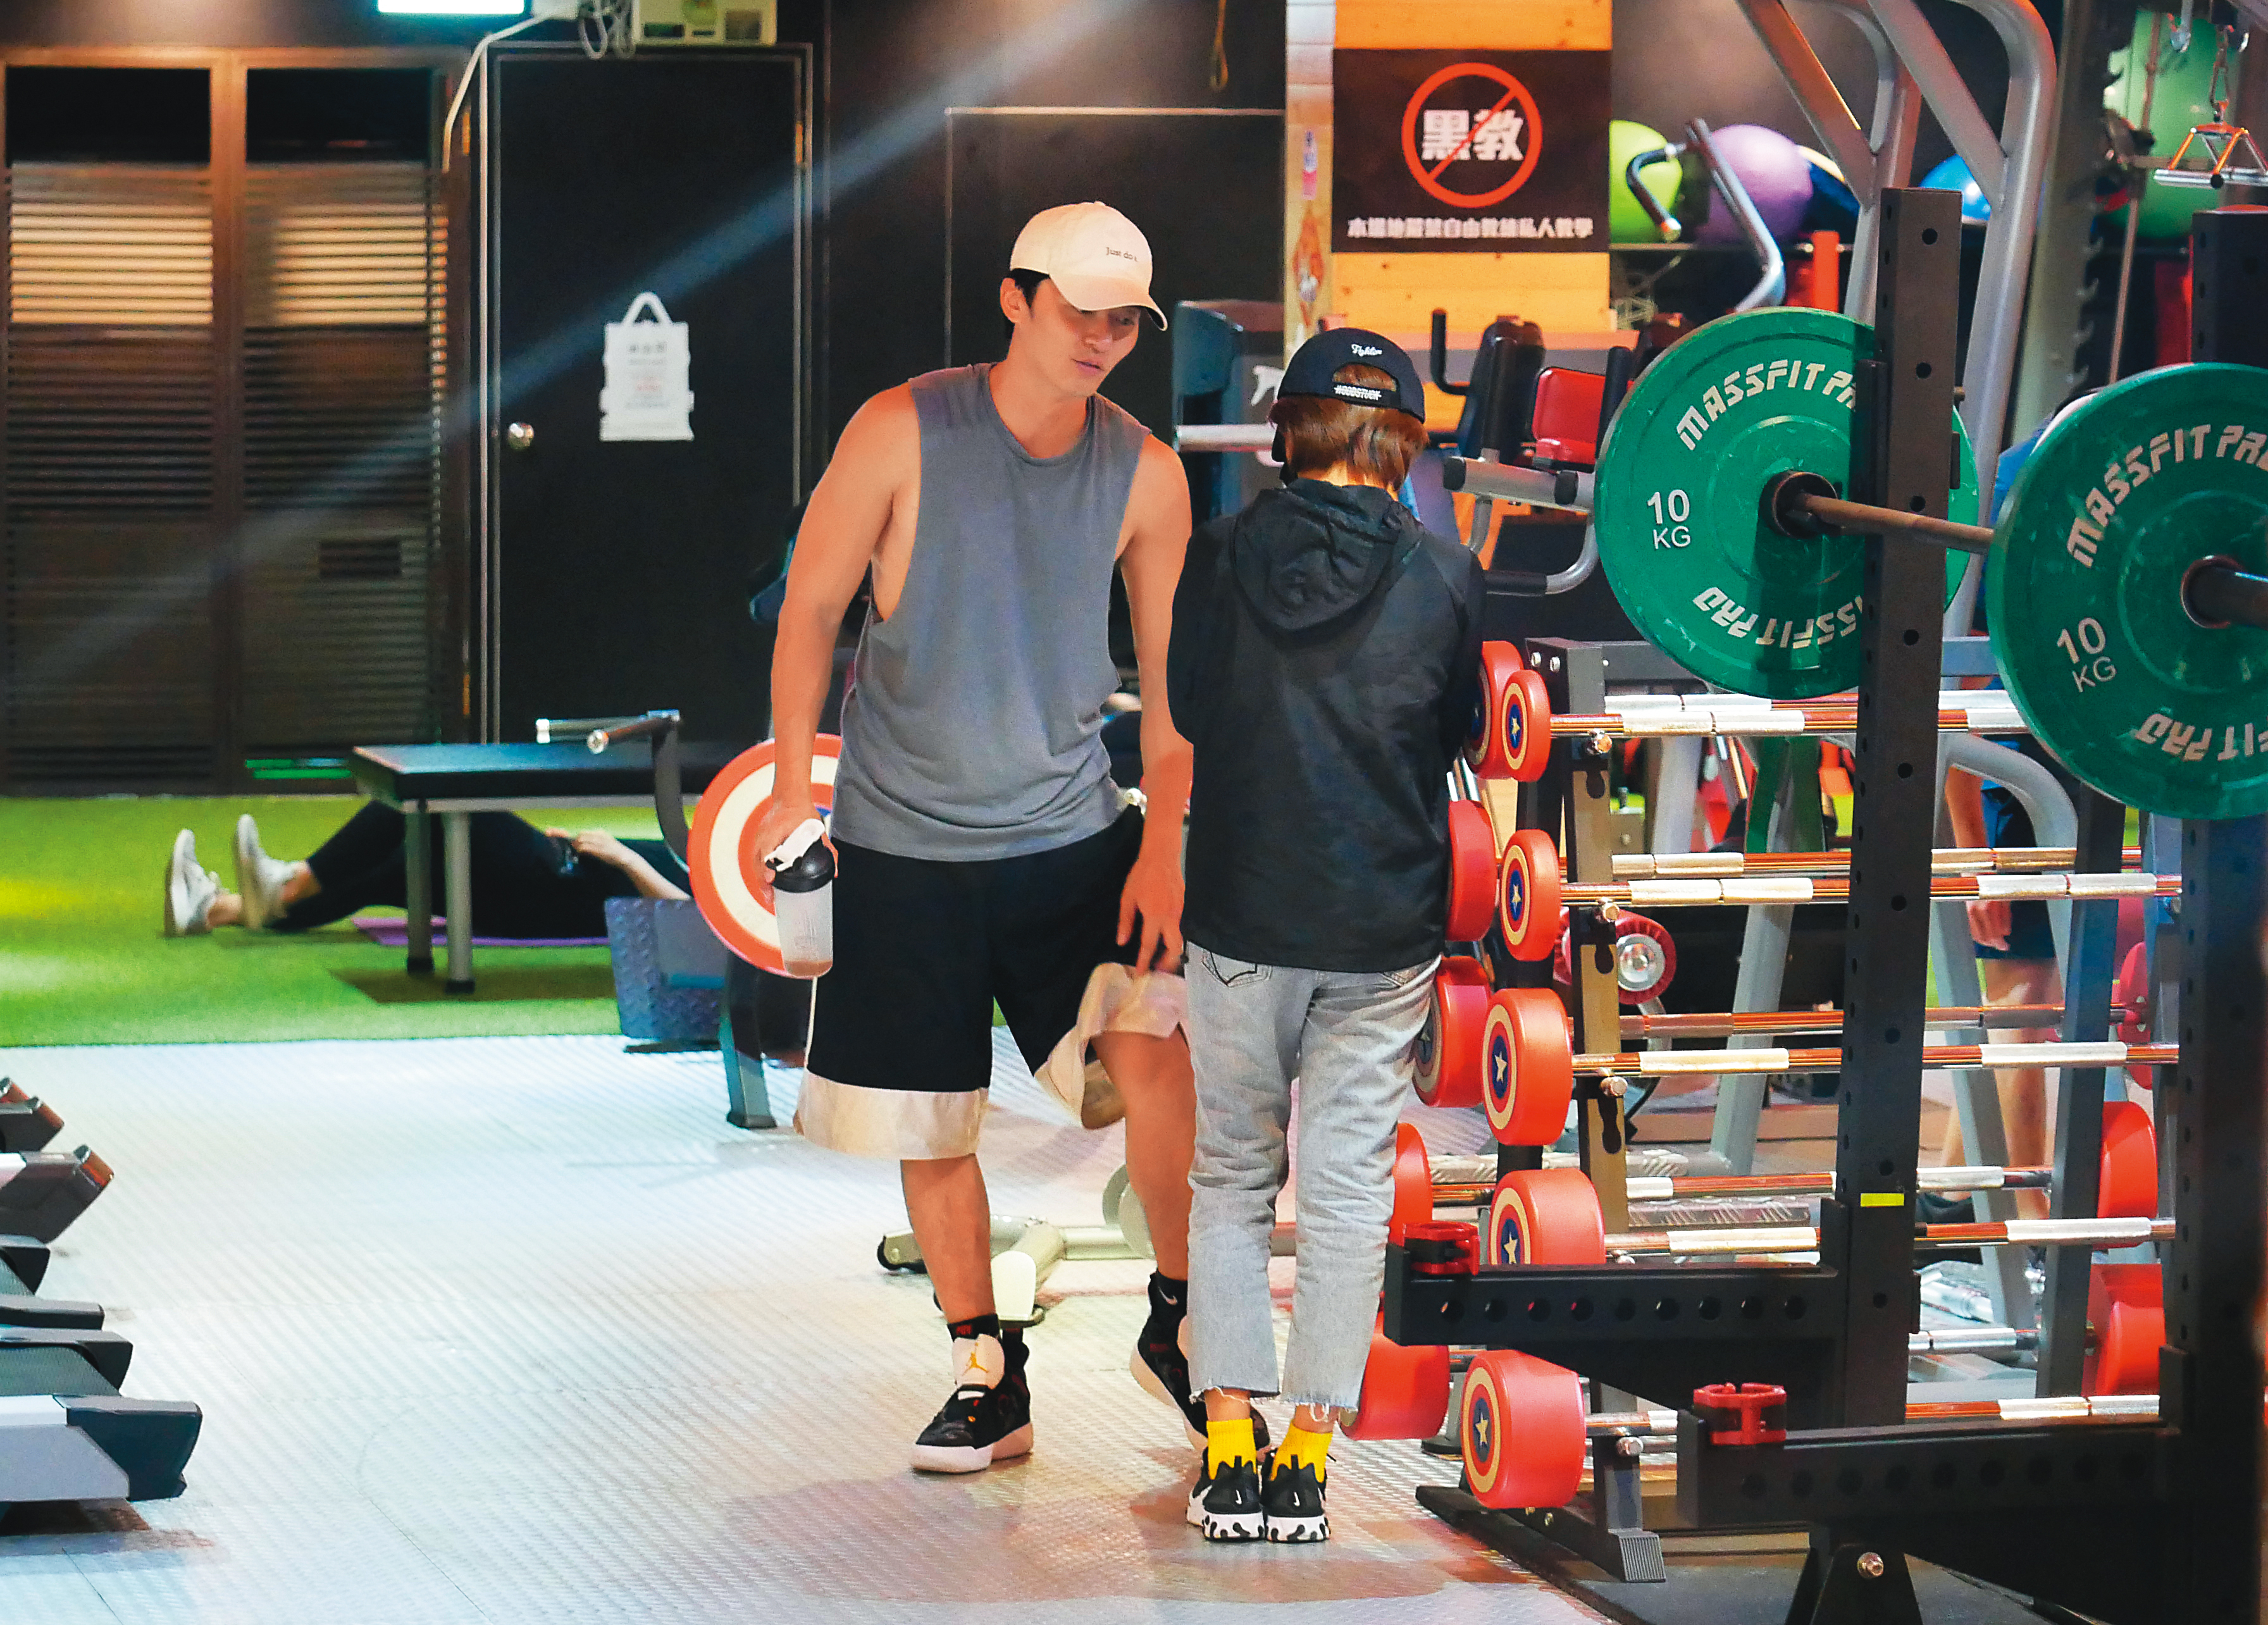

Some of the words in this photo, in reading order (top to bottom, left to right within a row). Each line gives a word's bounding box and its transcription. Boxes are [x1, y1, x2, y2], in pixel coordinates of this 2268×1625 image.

[1422, 109, 1524, 161] 黑教
[1676, 359, 1826, 451] MASSFIT
[1822, 371, 1856, 412] PR
[1647, 489, 1690, 524] 10
[2067, 424, 2211, 567] MASSFIT
[1653, 526, 1691, 549] KG
[1693, 587, 1759, 638] PRO
[1756, 595, 1863, 649] SSFIT
[2057, 617, 2106, 664] 10
[2072, 657, 2117, 693] KG
[2135, 714, 2213, 762] PRO
